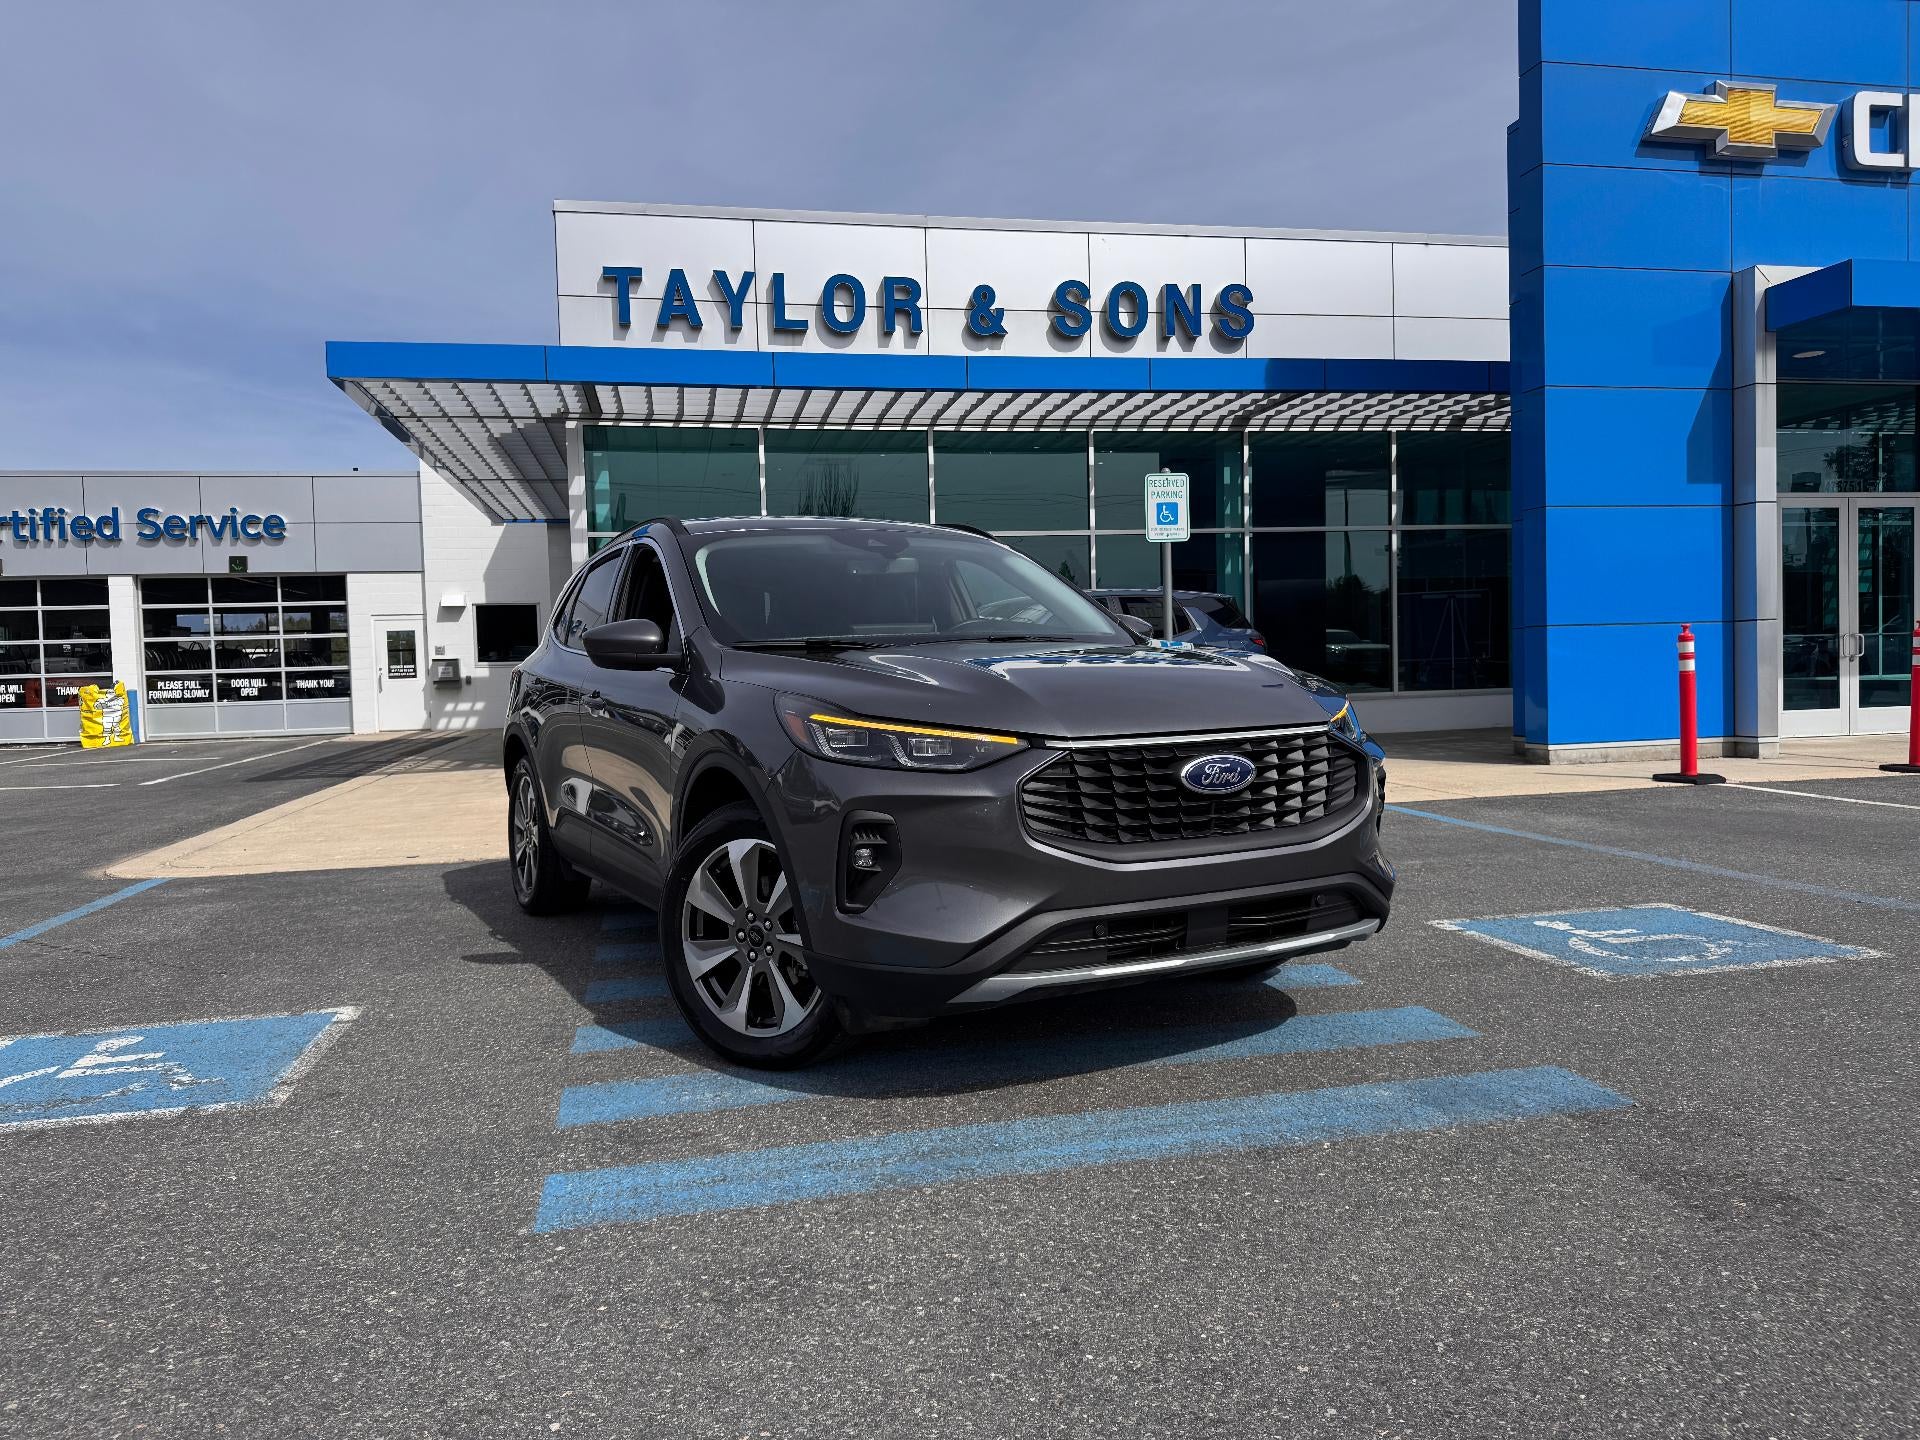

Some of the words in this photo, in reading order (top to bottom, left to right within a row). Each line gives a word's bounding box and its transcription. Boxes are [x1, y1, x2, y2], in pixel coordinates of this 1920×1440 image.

[1853, 91, 1919, 168] C
[602, 266, 924, 334] TAYLOR
[967, 284, 1008, 336] &
[1054, 280, 1255, 339] SONS
[1149, 479, 1185, 488] RESERVED
[1151, 491, 1183, 499] PARKING
[136, 507, 286, 540] Service
[157, 681, 183, 690] PLEASE
[184, 681, 201, 689] PULL
[231, 679, 249, 688] DOOR
[250, 678, 267, 688] WILL
[296, 680, 318, 689] THANK
[7, 684, 25, 694] WILL
[56, 686, 80, 696] THANK
[149, 690, 182, 699] FORWARD
[183, 689, 209, 698] SLOWLY
[240, 688, 258, 696] OPEN
[0, 694, 16, 703] PEN
[1201, 763, 1241, 785] Ford
